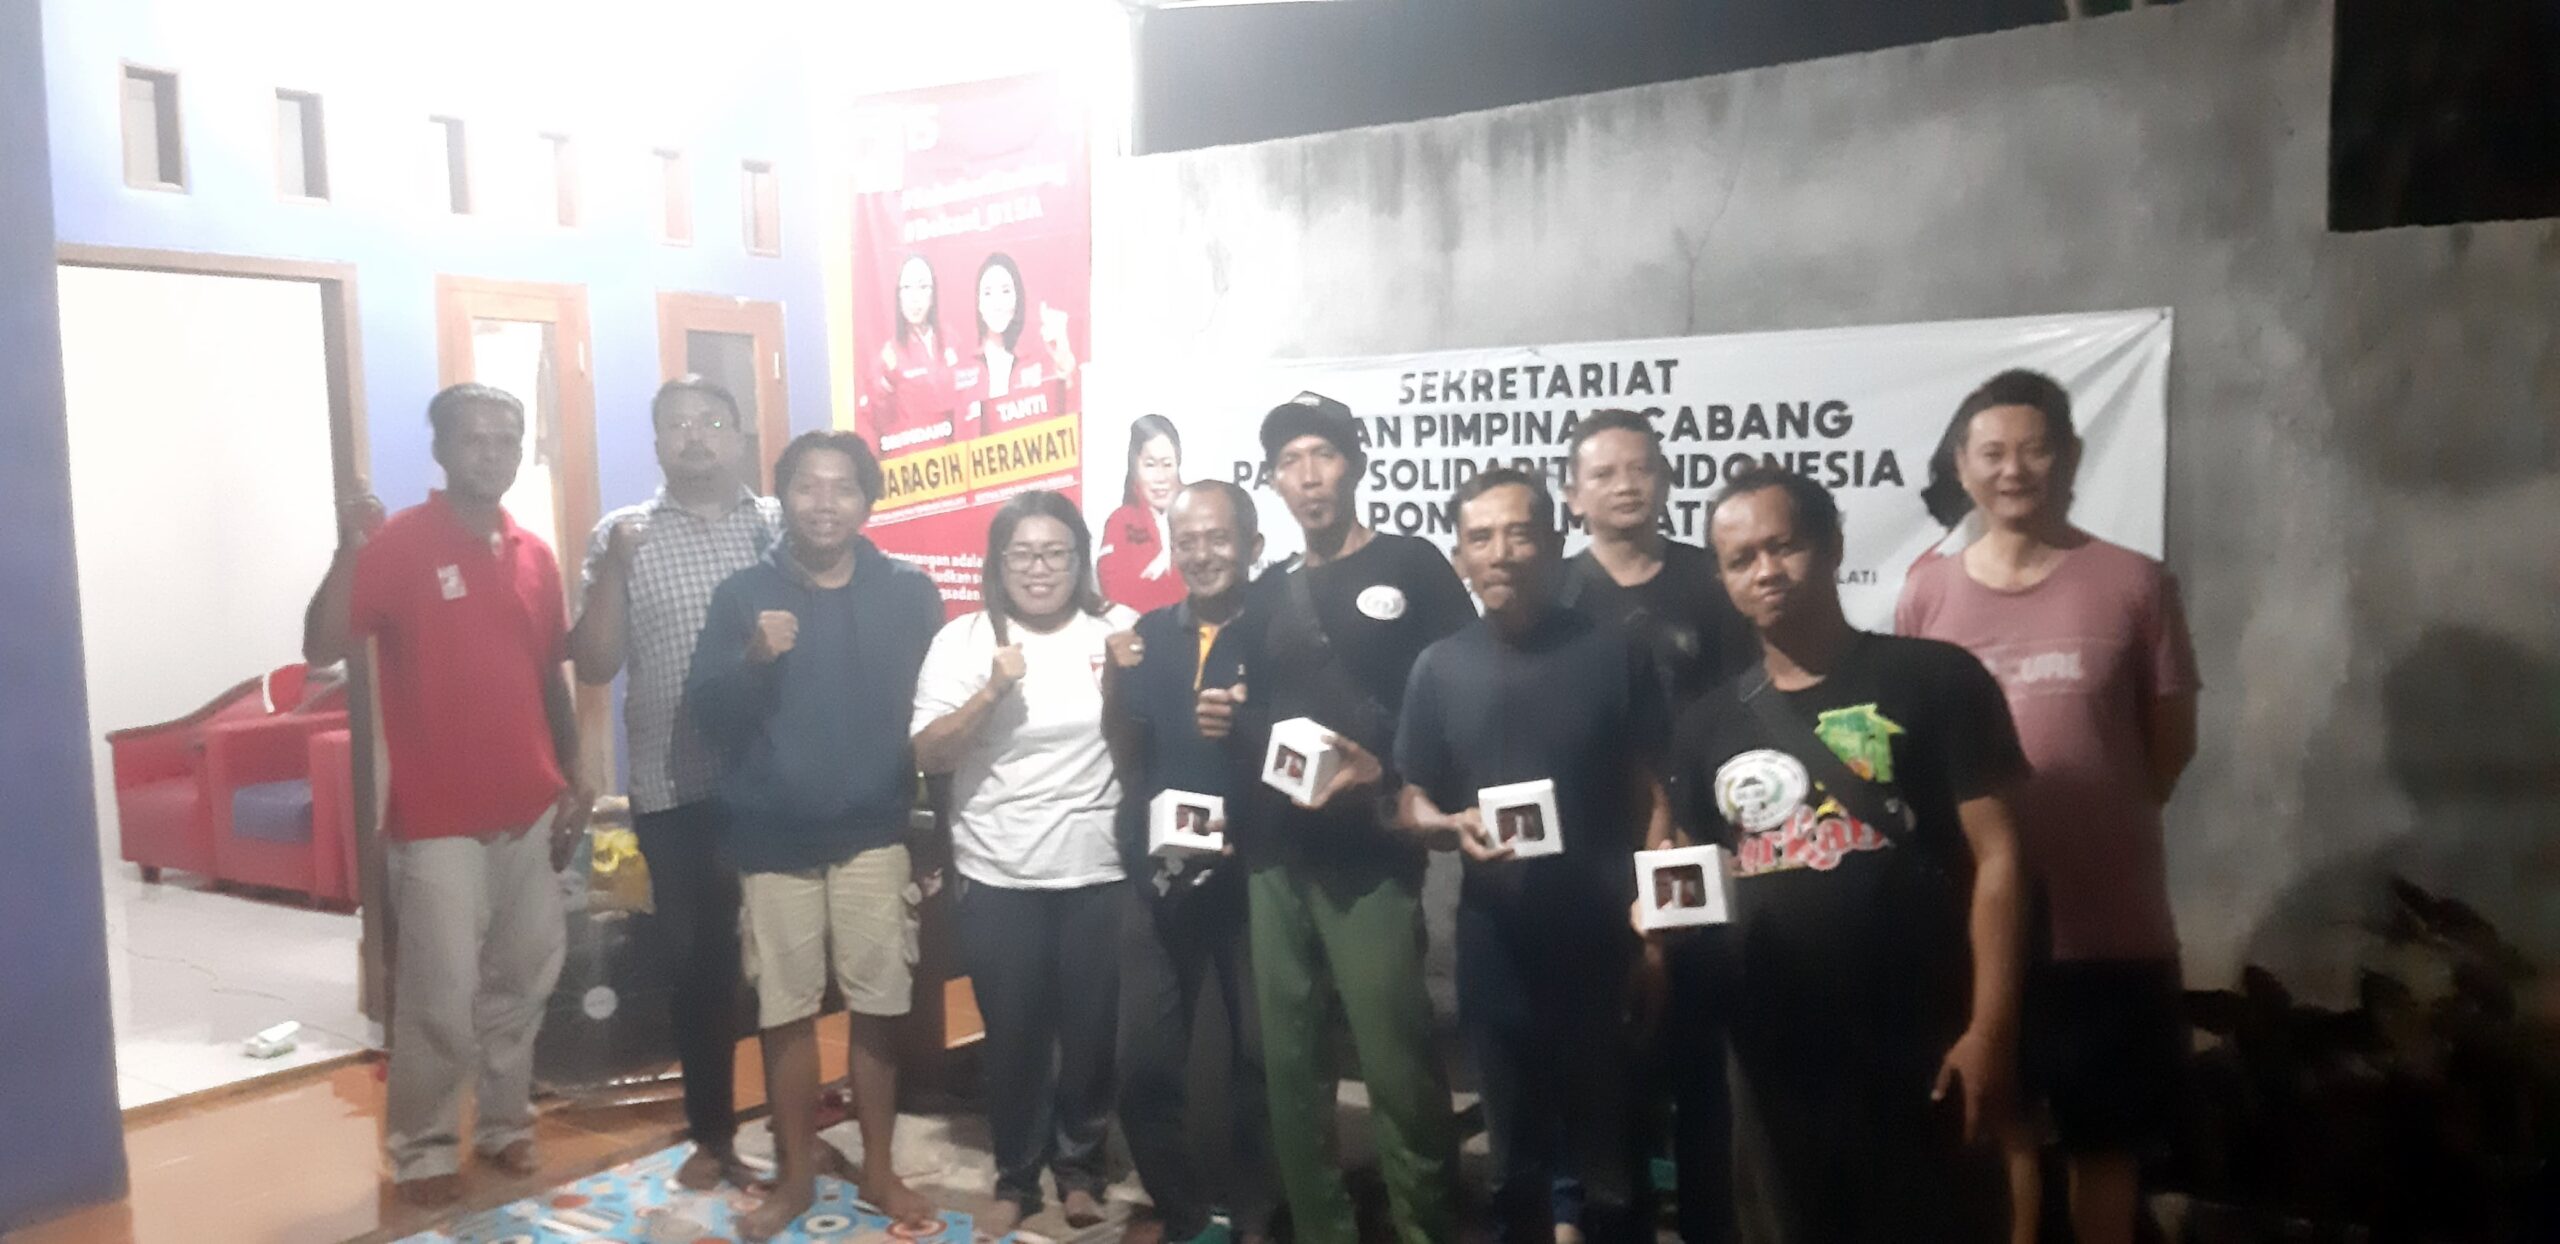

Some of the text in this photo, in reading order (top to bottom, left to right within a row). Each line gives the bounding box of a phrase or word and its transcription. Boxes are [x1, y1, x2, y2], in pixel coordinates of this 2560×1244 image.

[1398, 358, 1679, 406] SEKRETARIAT
[1414, 409, 1601, 448] PIMPINA
[886, 452, 964, 499] ARAGIH
[972, 427, 1077, 479] HERAWATI
[1662, 449, 1905, 489] NDONESIA
[1368, 501, 1457, 536] PON
